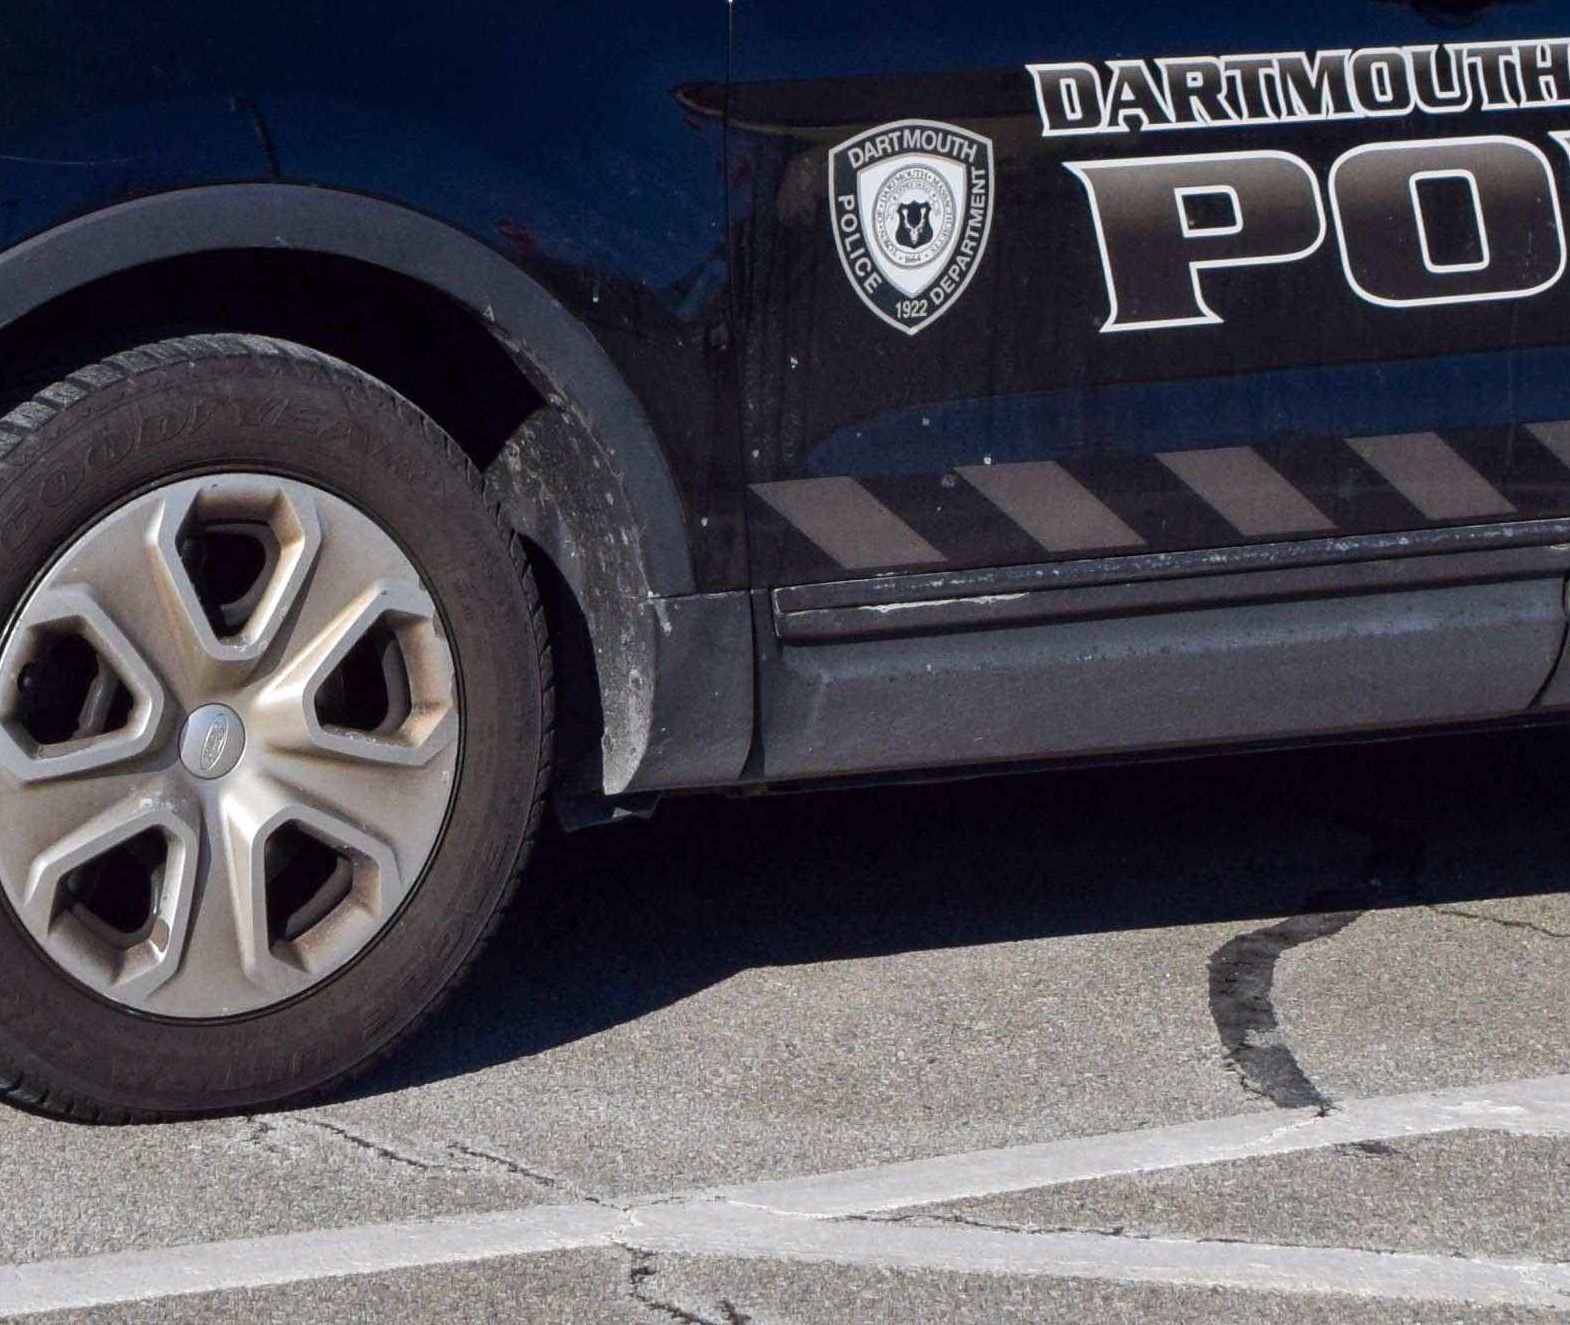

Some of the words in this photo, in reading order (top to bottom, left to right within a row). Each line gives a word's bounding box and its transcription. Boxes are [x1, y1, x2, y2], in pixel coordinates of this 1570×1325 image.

[847, 129, 978, 169] DARTMOUTH
[838, 194, 883, 295] POLICE
[895, 299, 929, 319] 1922
[930, 166, 987, 306] DEPARTMENT
